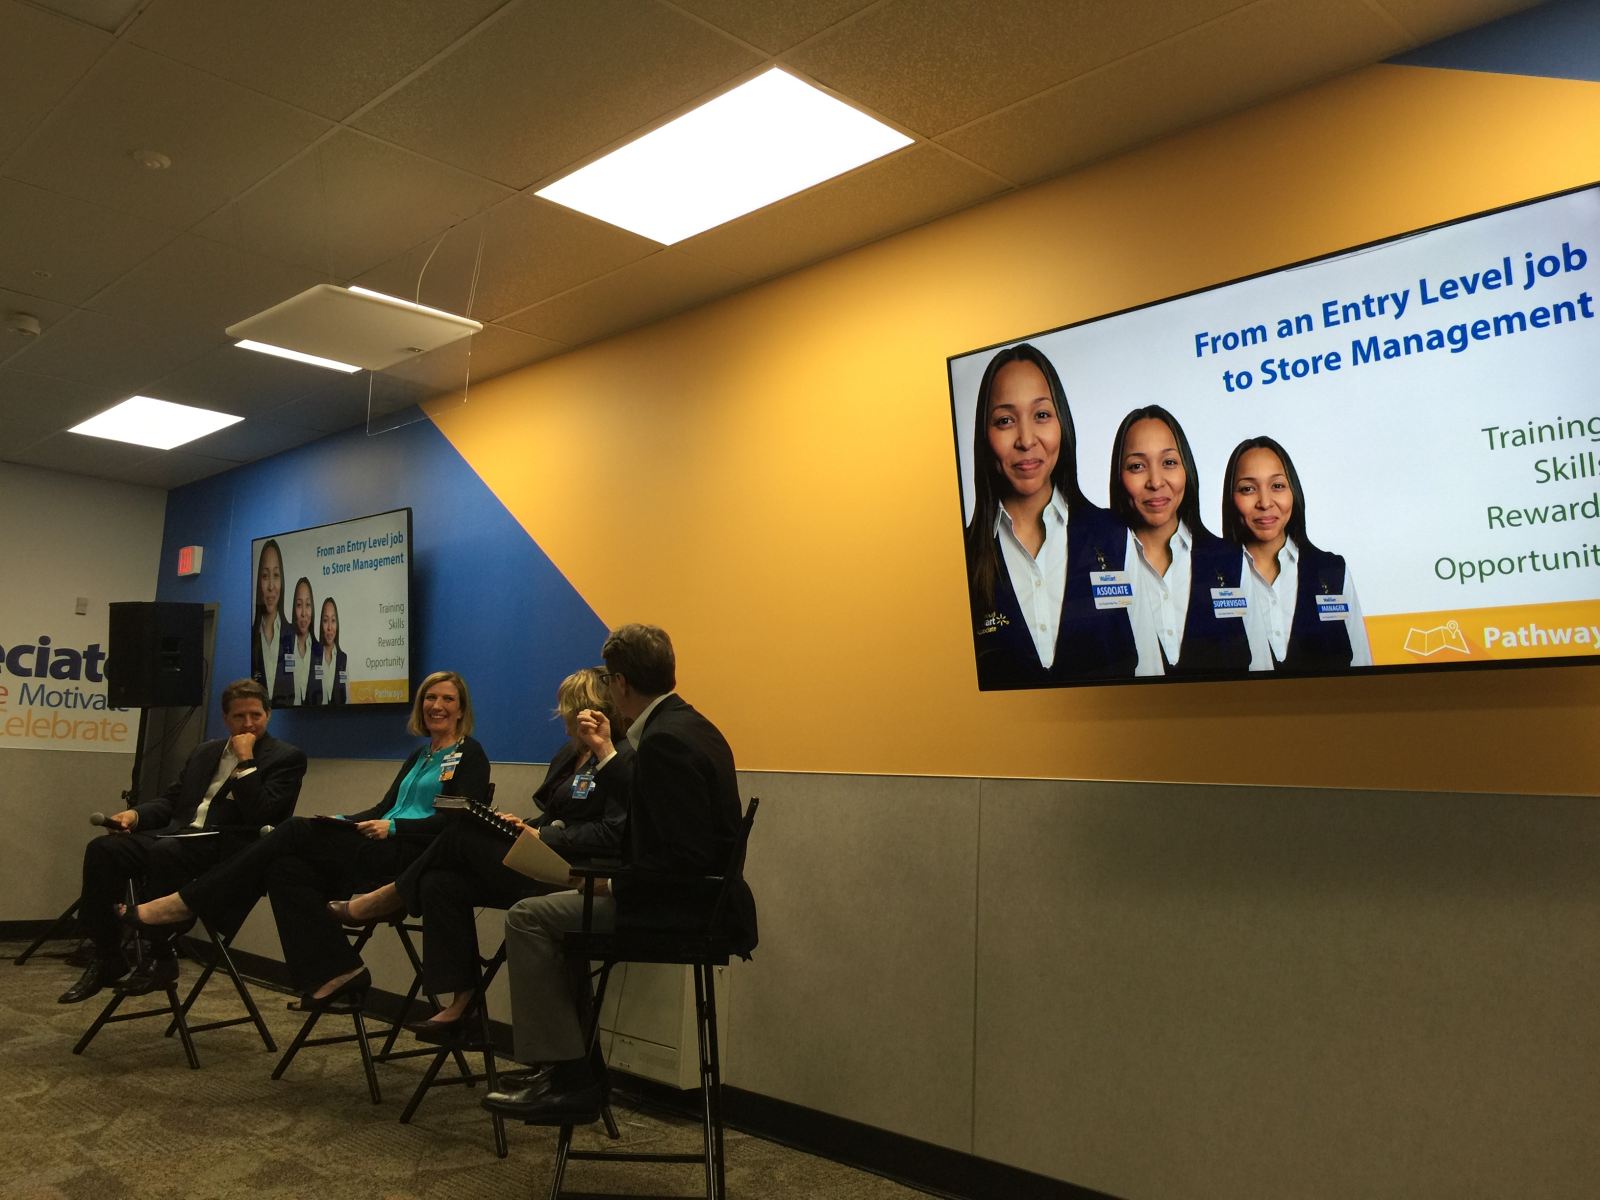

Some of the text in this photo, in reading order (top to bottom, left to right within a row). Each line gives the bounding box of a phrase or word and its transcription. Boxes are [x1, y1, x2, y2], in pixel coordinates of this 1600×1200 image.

[1194, 242, 1588, 357] From an Entry Level job
[1222, 291, 1595, 393] to Store Management
[1481, 416, 1600, 450] Training
[1534, 451, 1600, 483] Skill
[1487, 492, 1600, 529] Reward
[316, 531, 404, 557] From an Entry Level job
[322, 552, 404, 576] to Store Management
[1434, 544, 1600, 584] Opportunit
[1096, 585, 1129, 596] ASSOCIATE
[1213, 599, 1246, 608] SUPERVISOR
[378, 603, 404, 615] Training
[1321, 604, 1346, 612] MANAGER
[388, 617, 404, 630] Skills
[378, 635, 404, 647] Rewards
[0, 635, 109, 682] ciat
[365, 656, 405, 670] Opportunity
[18, 683, 129, 712] Motiva
[0, 708, 128, 742] elebrate
